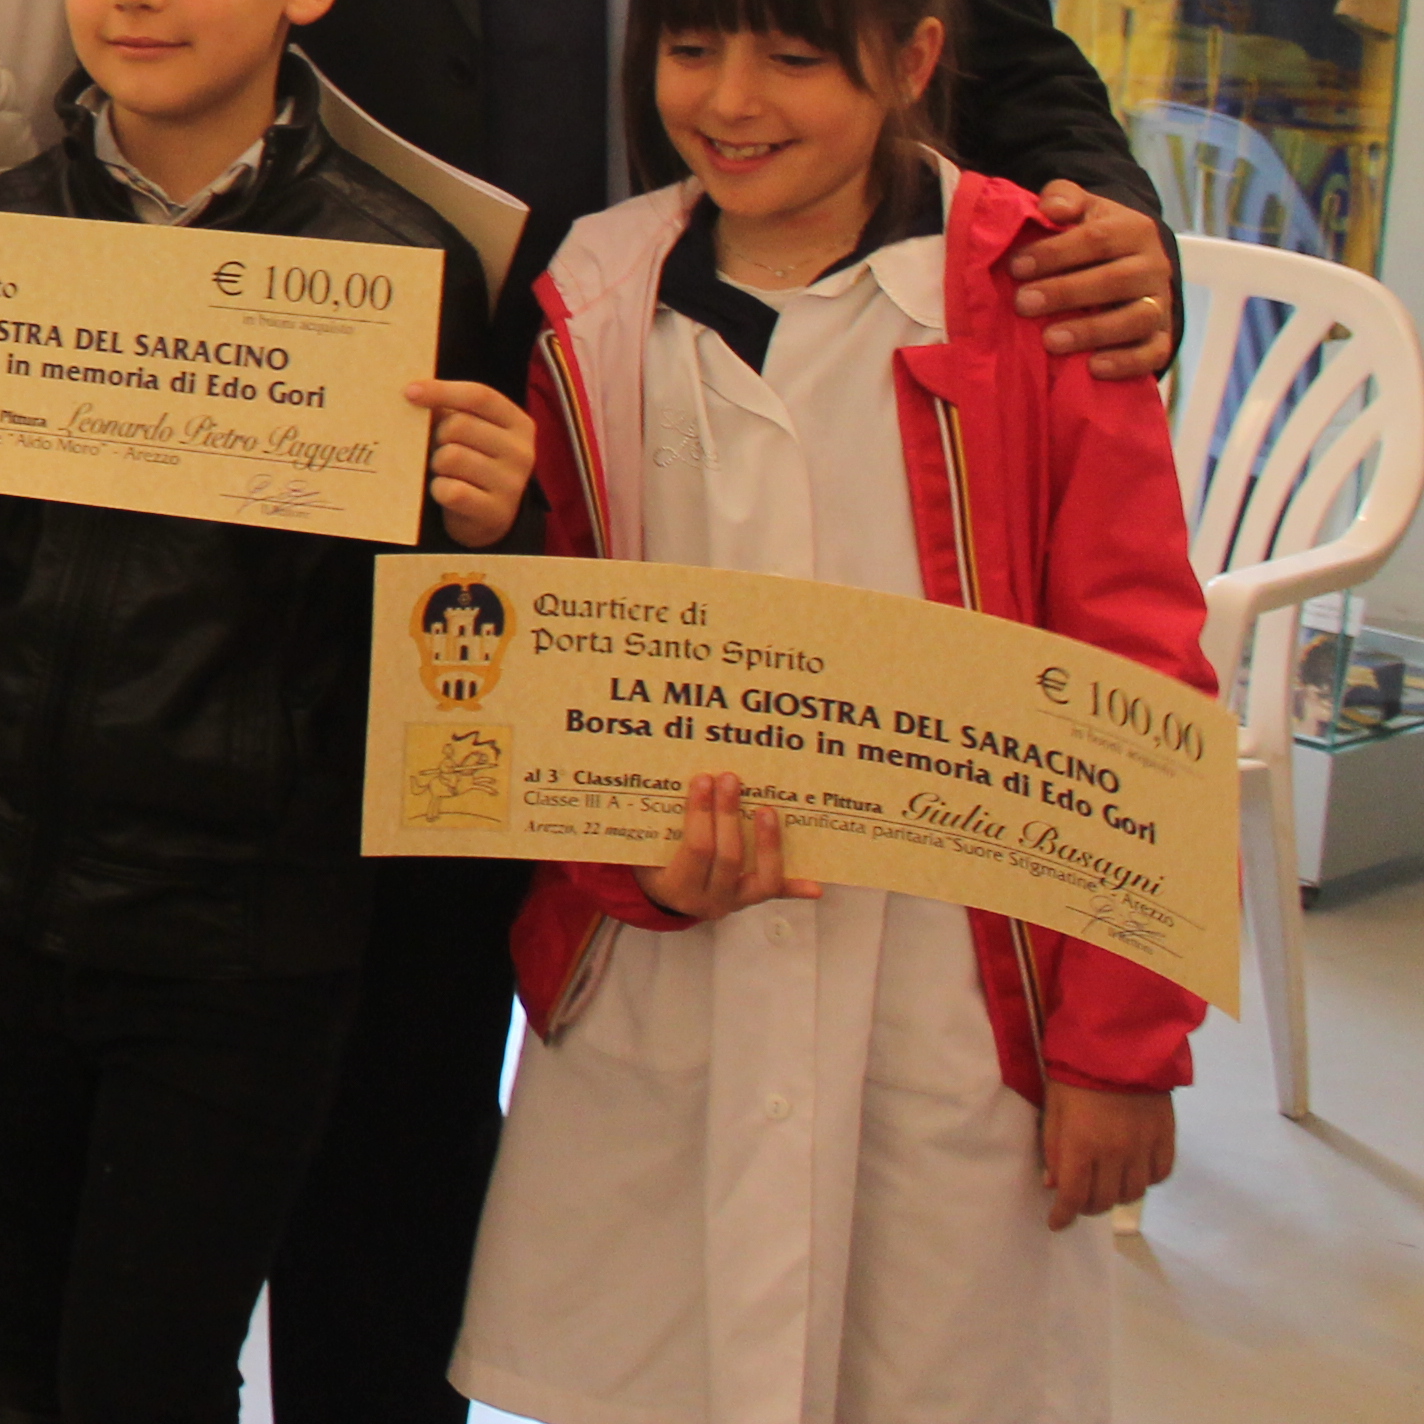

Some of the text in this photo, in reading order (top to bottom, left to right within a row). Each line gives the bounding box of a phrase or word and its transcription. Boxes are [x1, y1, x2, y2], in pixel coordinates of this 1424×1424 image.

[212, 261, 393, 312] € 100,00
[74, 328, 122, 354] DEL
[134, 335, 290, 370] SARACINO
[7, 354, 30, 376] in
[41, 362, 159, 391] memoria
[170, 372, 195, 394] di
[207, 375, 256, 400] Edo
[269, 381, 325, 408] Gori
[0, 410, 47, 427] Pittura
[56, 402, 173, 443] Leonardo
[179, 414, 259, 452] Pietro
[534, 593, 708, 626] Quartiere di
[531, 628, 824, 674] Porta Santo Spirito
[610, 677, 650, 703] LA
[663, 681, 728, 709] MIA
[742, 688, 880, 729] GIOSTRA
[894, 710, 950, 743] DEL
[961, 726, 1120, 794] SARACINO
[1036, 667, 1070, 704] €
[1090, 681, 1204, 762] 100,00
[524, 769, 540, 783] al
[574, 770, 682, 791] Classificato
[566, 708, 1156, 845] Borsa di studio in memoria di Edo Gori
[583, 823, 600, 835] 22
[605, 825, 658, 840] maggio
[805, 794, 815, 805] e
[822, 792, 883, 814] Pittura
[902, 791, 1006, 841] Giulia
[1018, 820, 1165, 897] Basagni
[1123, 894, 1174, 928] Arezzo
